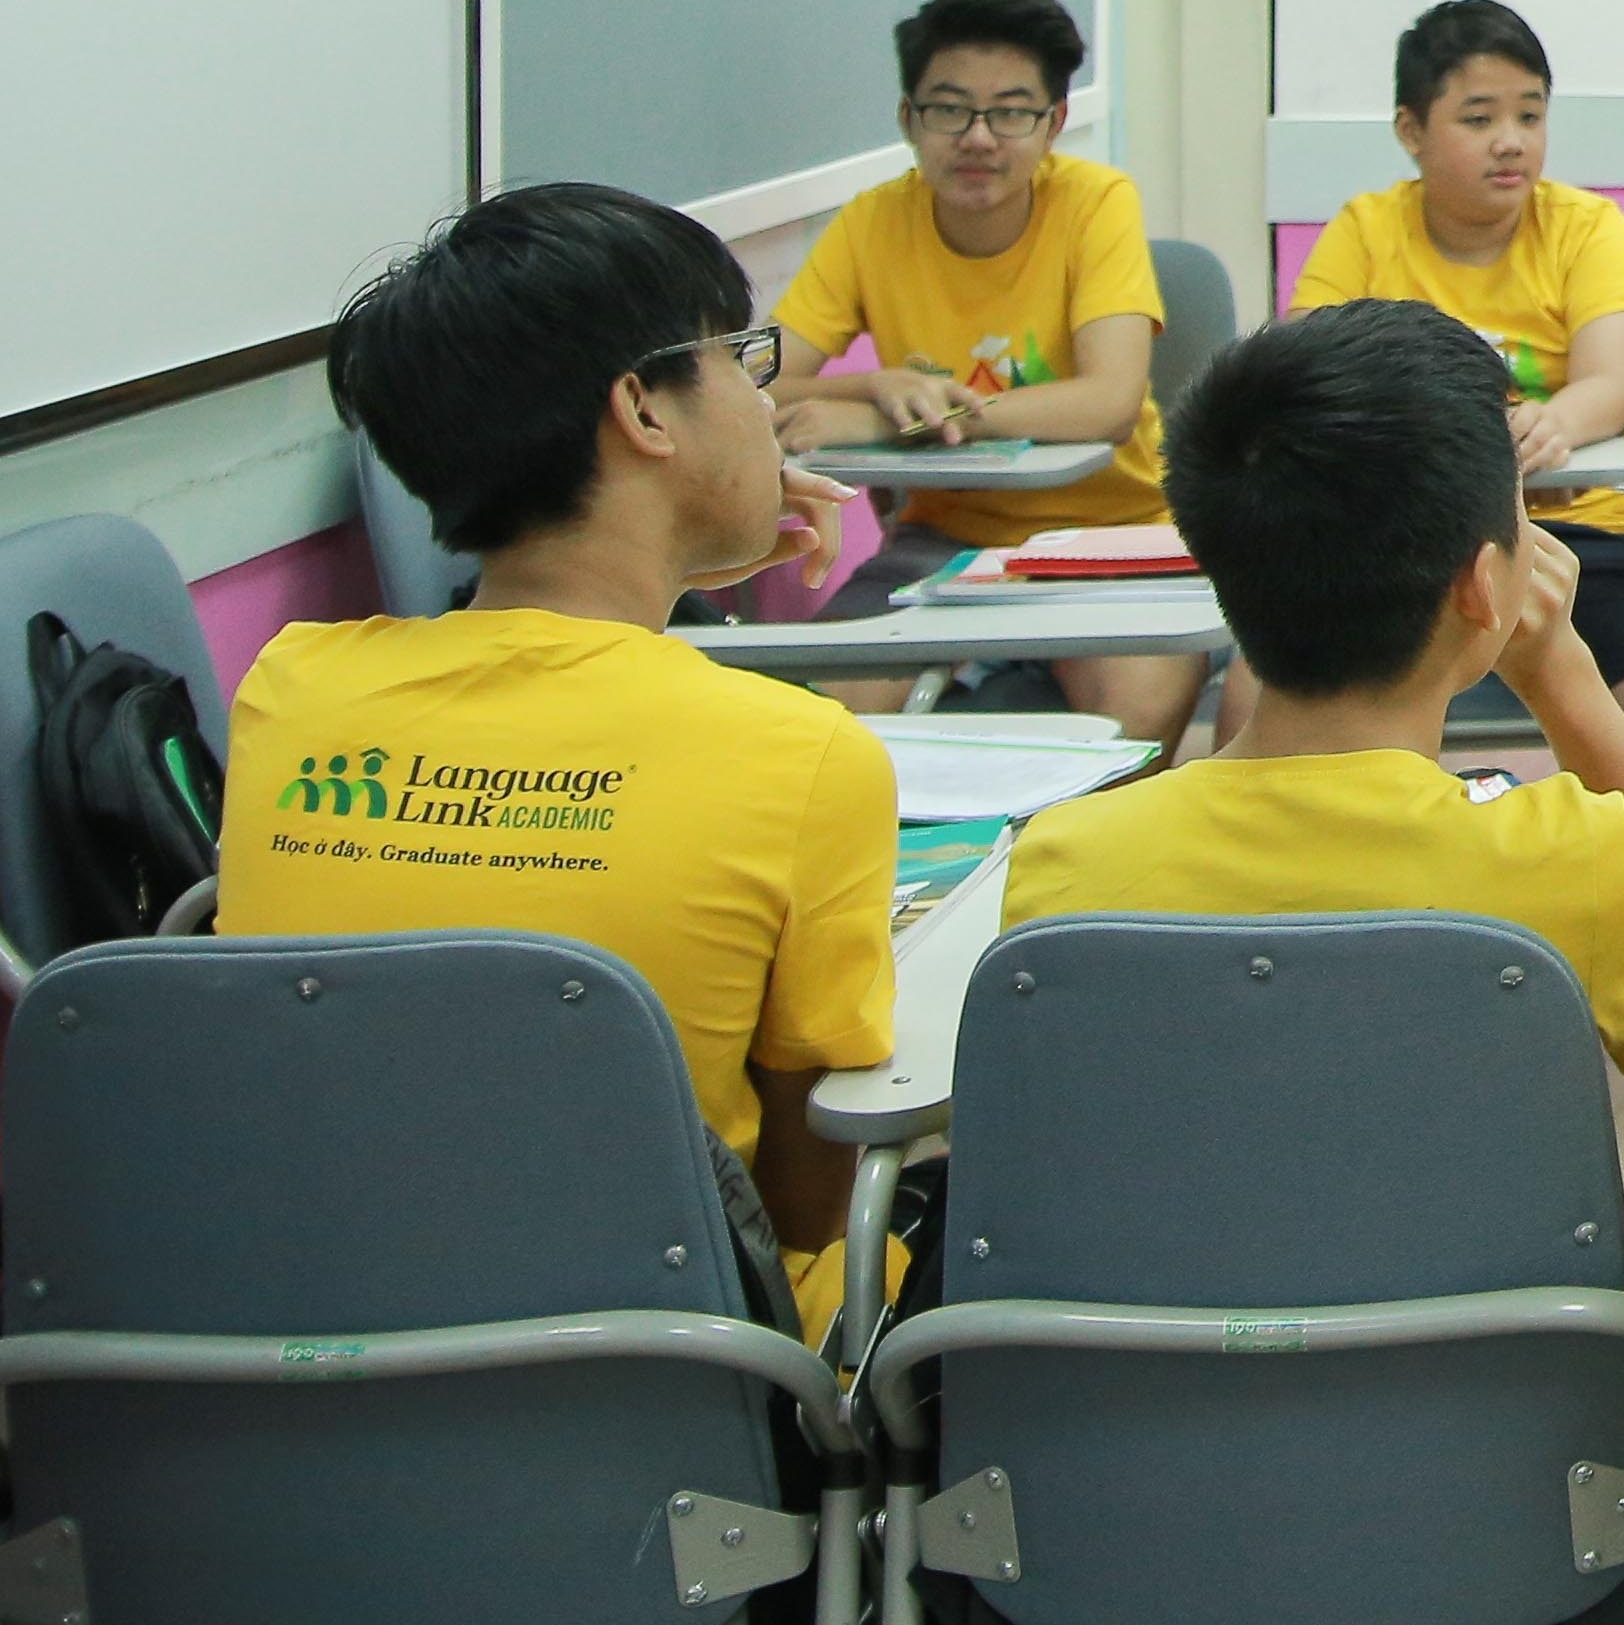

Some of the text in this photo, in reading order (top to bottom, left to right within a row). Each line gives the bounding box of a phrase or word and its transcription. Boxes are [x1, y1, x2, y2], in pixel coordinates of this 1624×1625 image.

[405, 755, 623, 802] Language
[497, 806, 614, 831] ACADEMIC
[271, 834, 609, 872] Học ở đây. Graduate anywhere.
